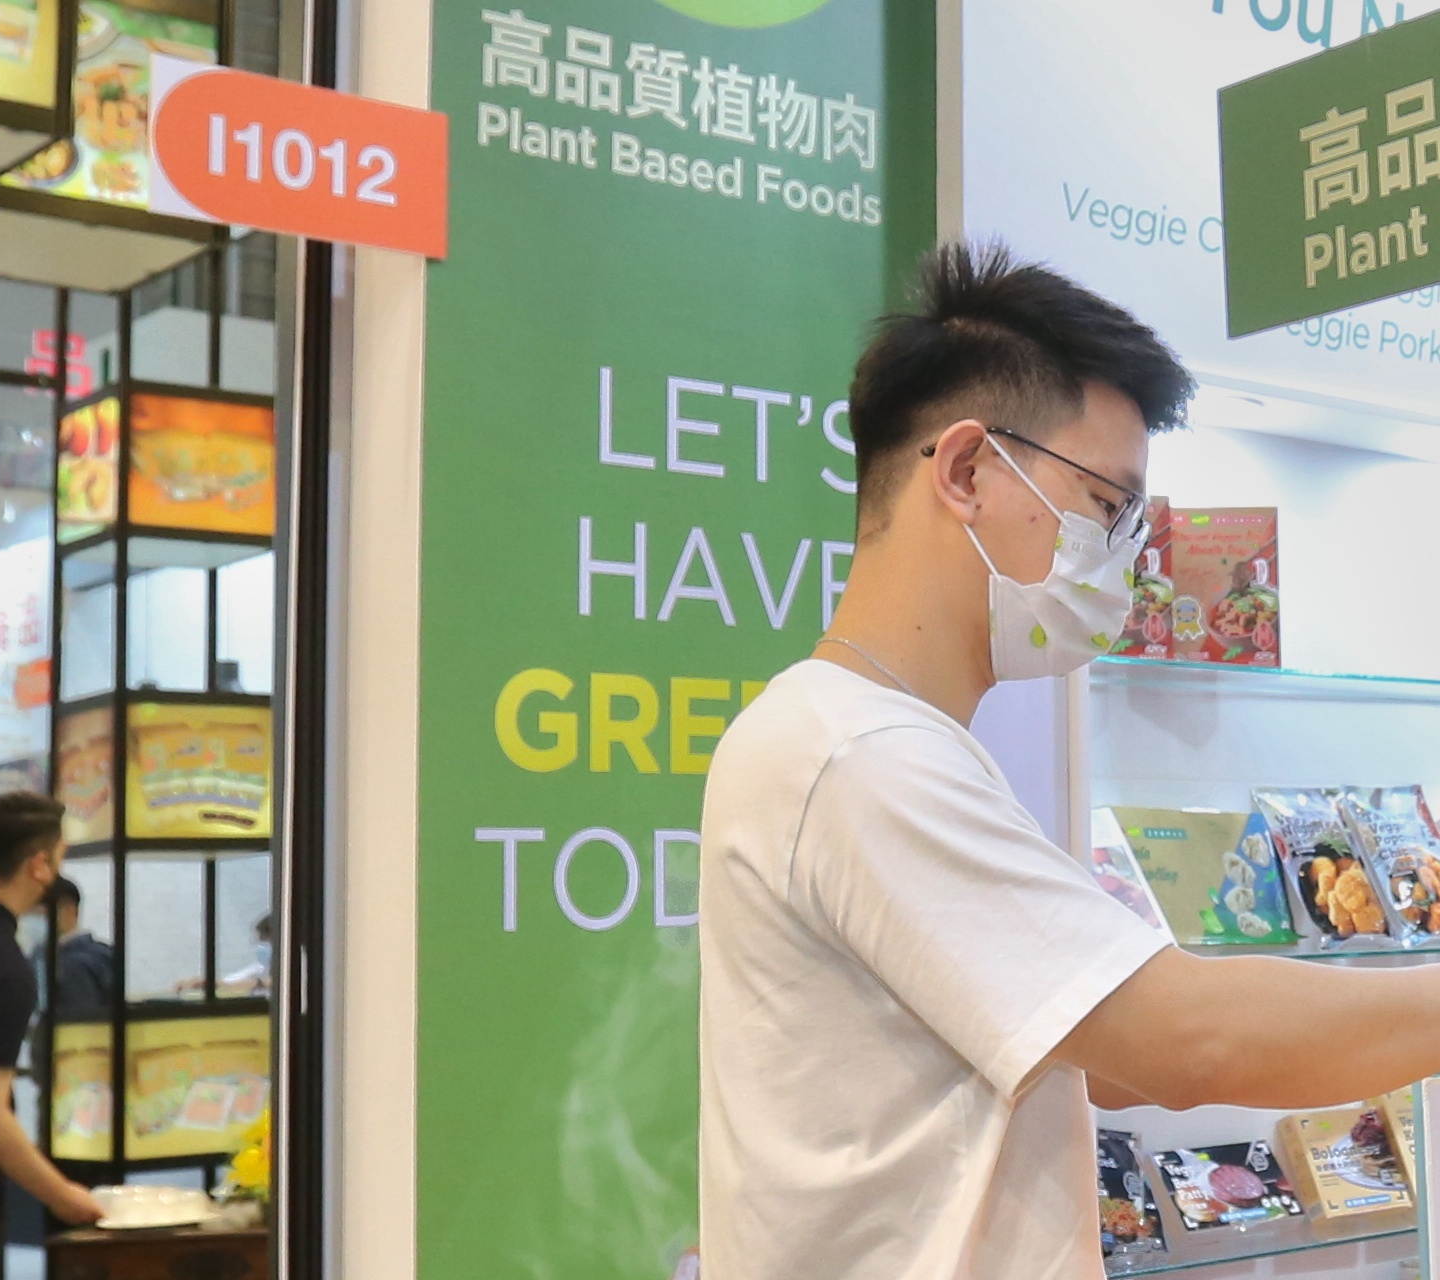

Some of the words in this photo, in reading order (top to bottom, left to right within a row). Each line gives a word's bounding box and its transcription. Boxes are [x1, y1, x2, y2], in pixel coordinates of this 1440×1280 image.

[481, 9, 878, 170] 高品質植物肉
[207, 113, 399, 206] I1012
[477, 102, 598, 169] Plant
[611, 132, 745, 199] Based
[756, 166, 883, 226] Foods
[1061, 182, 1189, 248] Veggie
[1303, 210, 1428, 289] Plant
[1286, 313, 1371, 352] eggie
[494, 667, 766, 775] GRE
